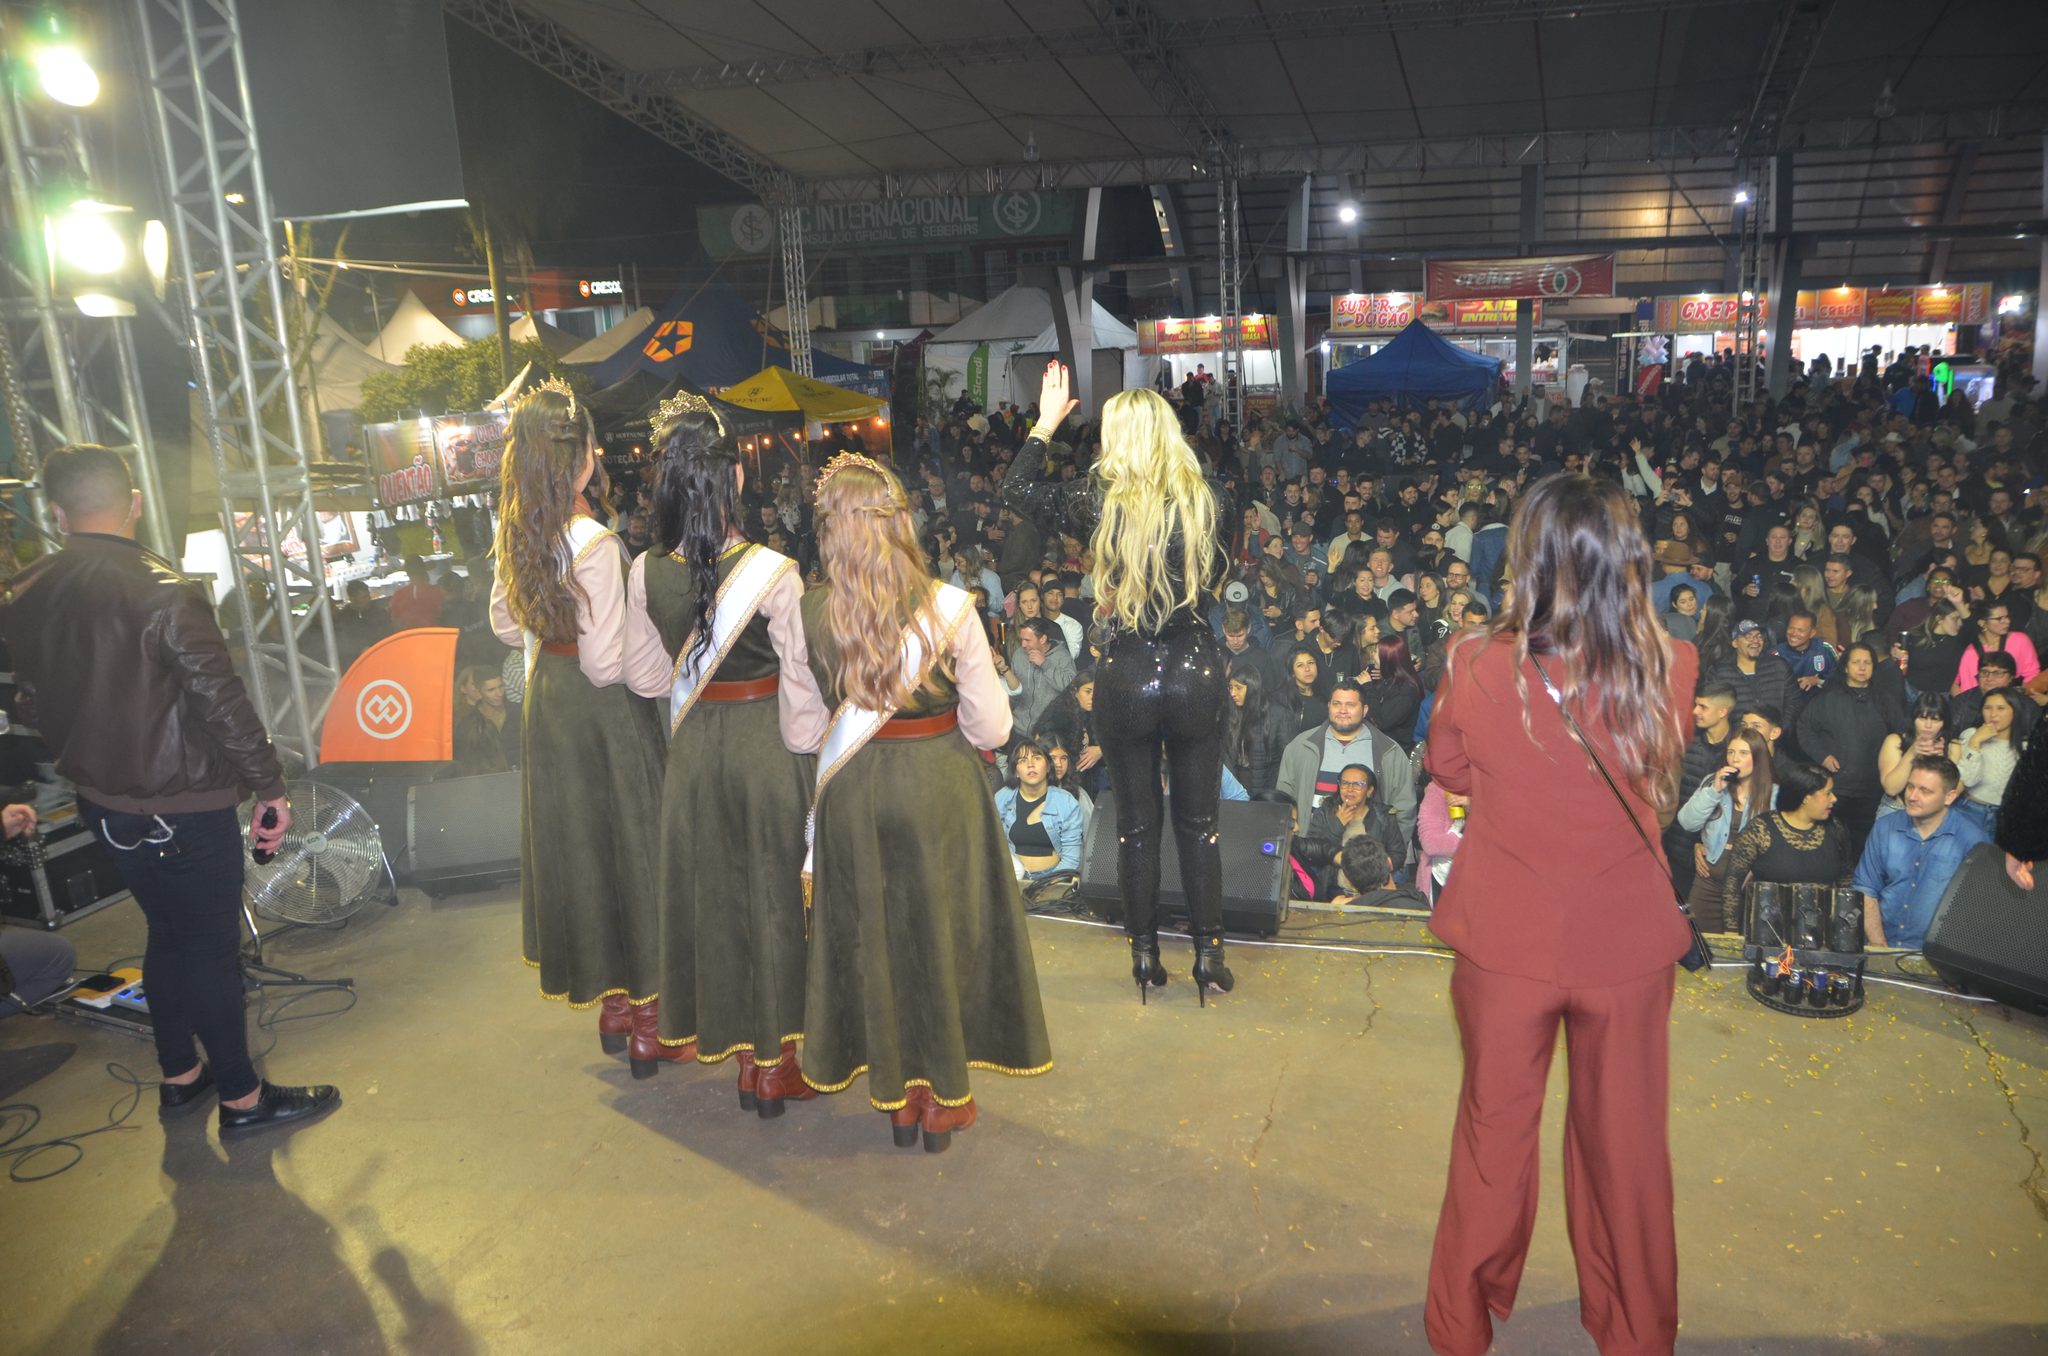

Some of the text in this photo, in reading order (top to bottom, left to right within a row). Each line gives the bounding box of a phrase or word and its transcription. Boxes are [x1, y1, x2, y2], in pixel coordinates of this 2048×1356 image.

[815, 196, 978, 233] INTERNACIONAL
[855, 225, 897, 242] OFICIAL
[902, 226, 917, 239] DE
[1338, 299, 1389, 314] SUPER
[1818, 304, 1863, 318] CREPE
[1461, 312, 1536, 323] ENTREVE
[973, 356, 982, 396] Sicredi
[380, 454, 432, 507] QUENTÃO
